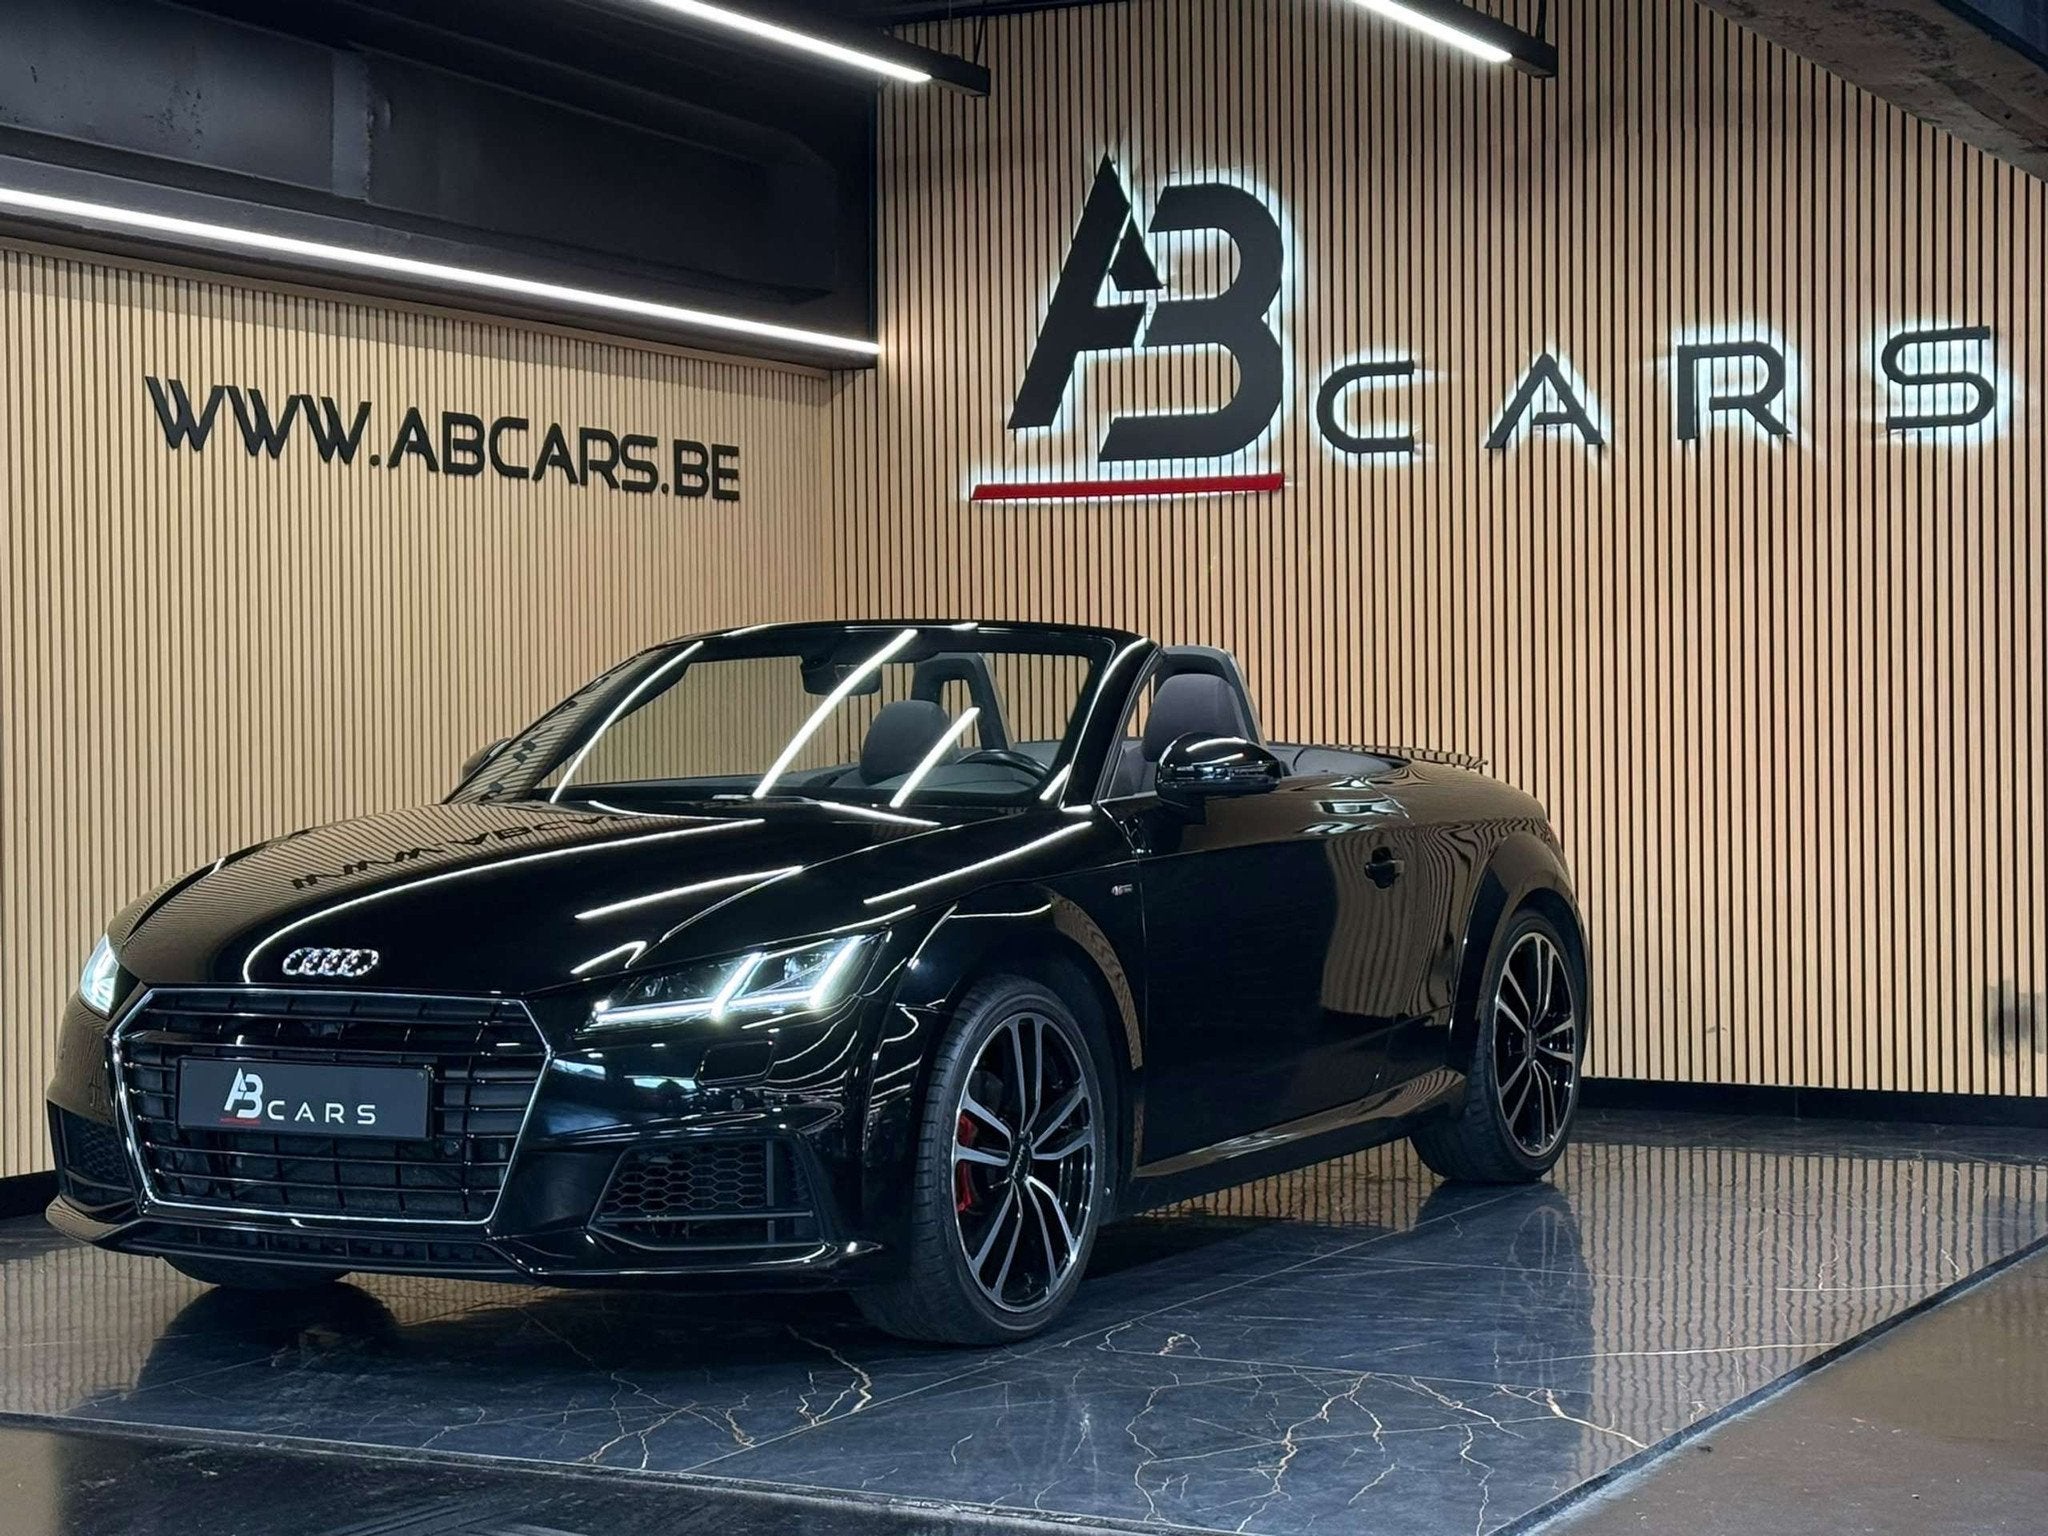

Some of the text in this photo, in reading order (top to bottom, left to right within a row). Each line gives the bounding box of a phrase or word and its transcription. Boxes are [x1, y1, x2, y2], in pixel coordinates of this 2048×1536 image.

[1007, 152, 1995, 463] AB CARS
[144, 375, 740, 501] WWW.ABCARS.BE
[224, 1067, 376, 1125] AB CARS
